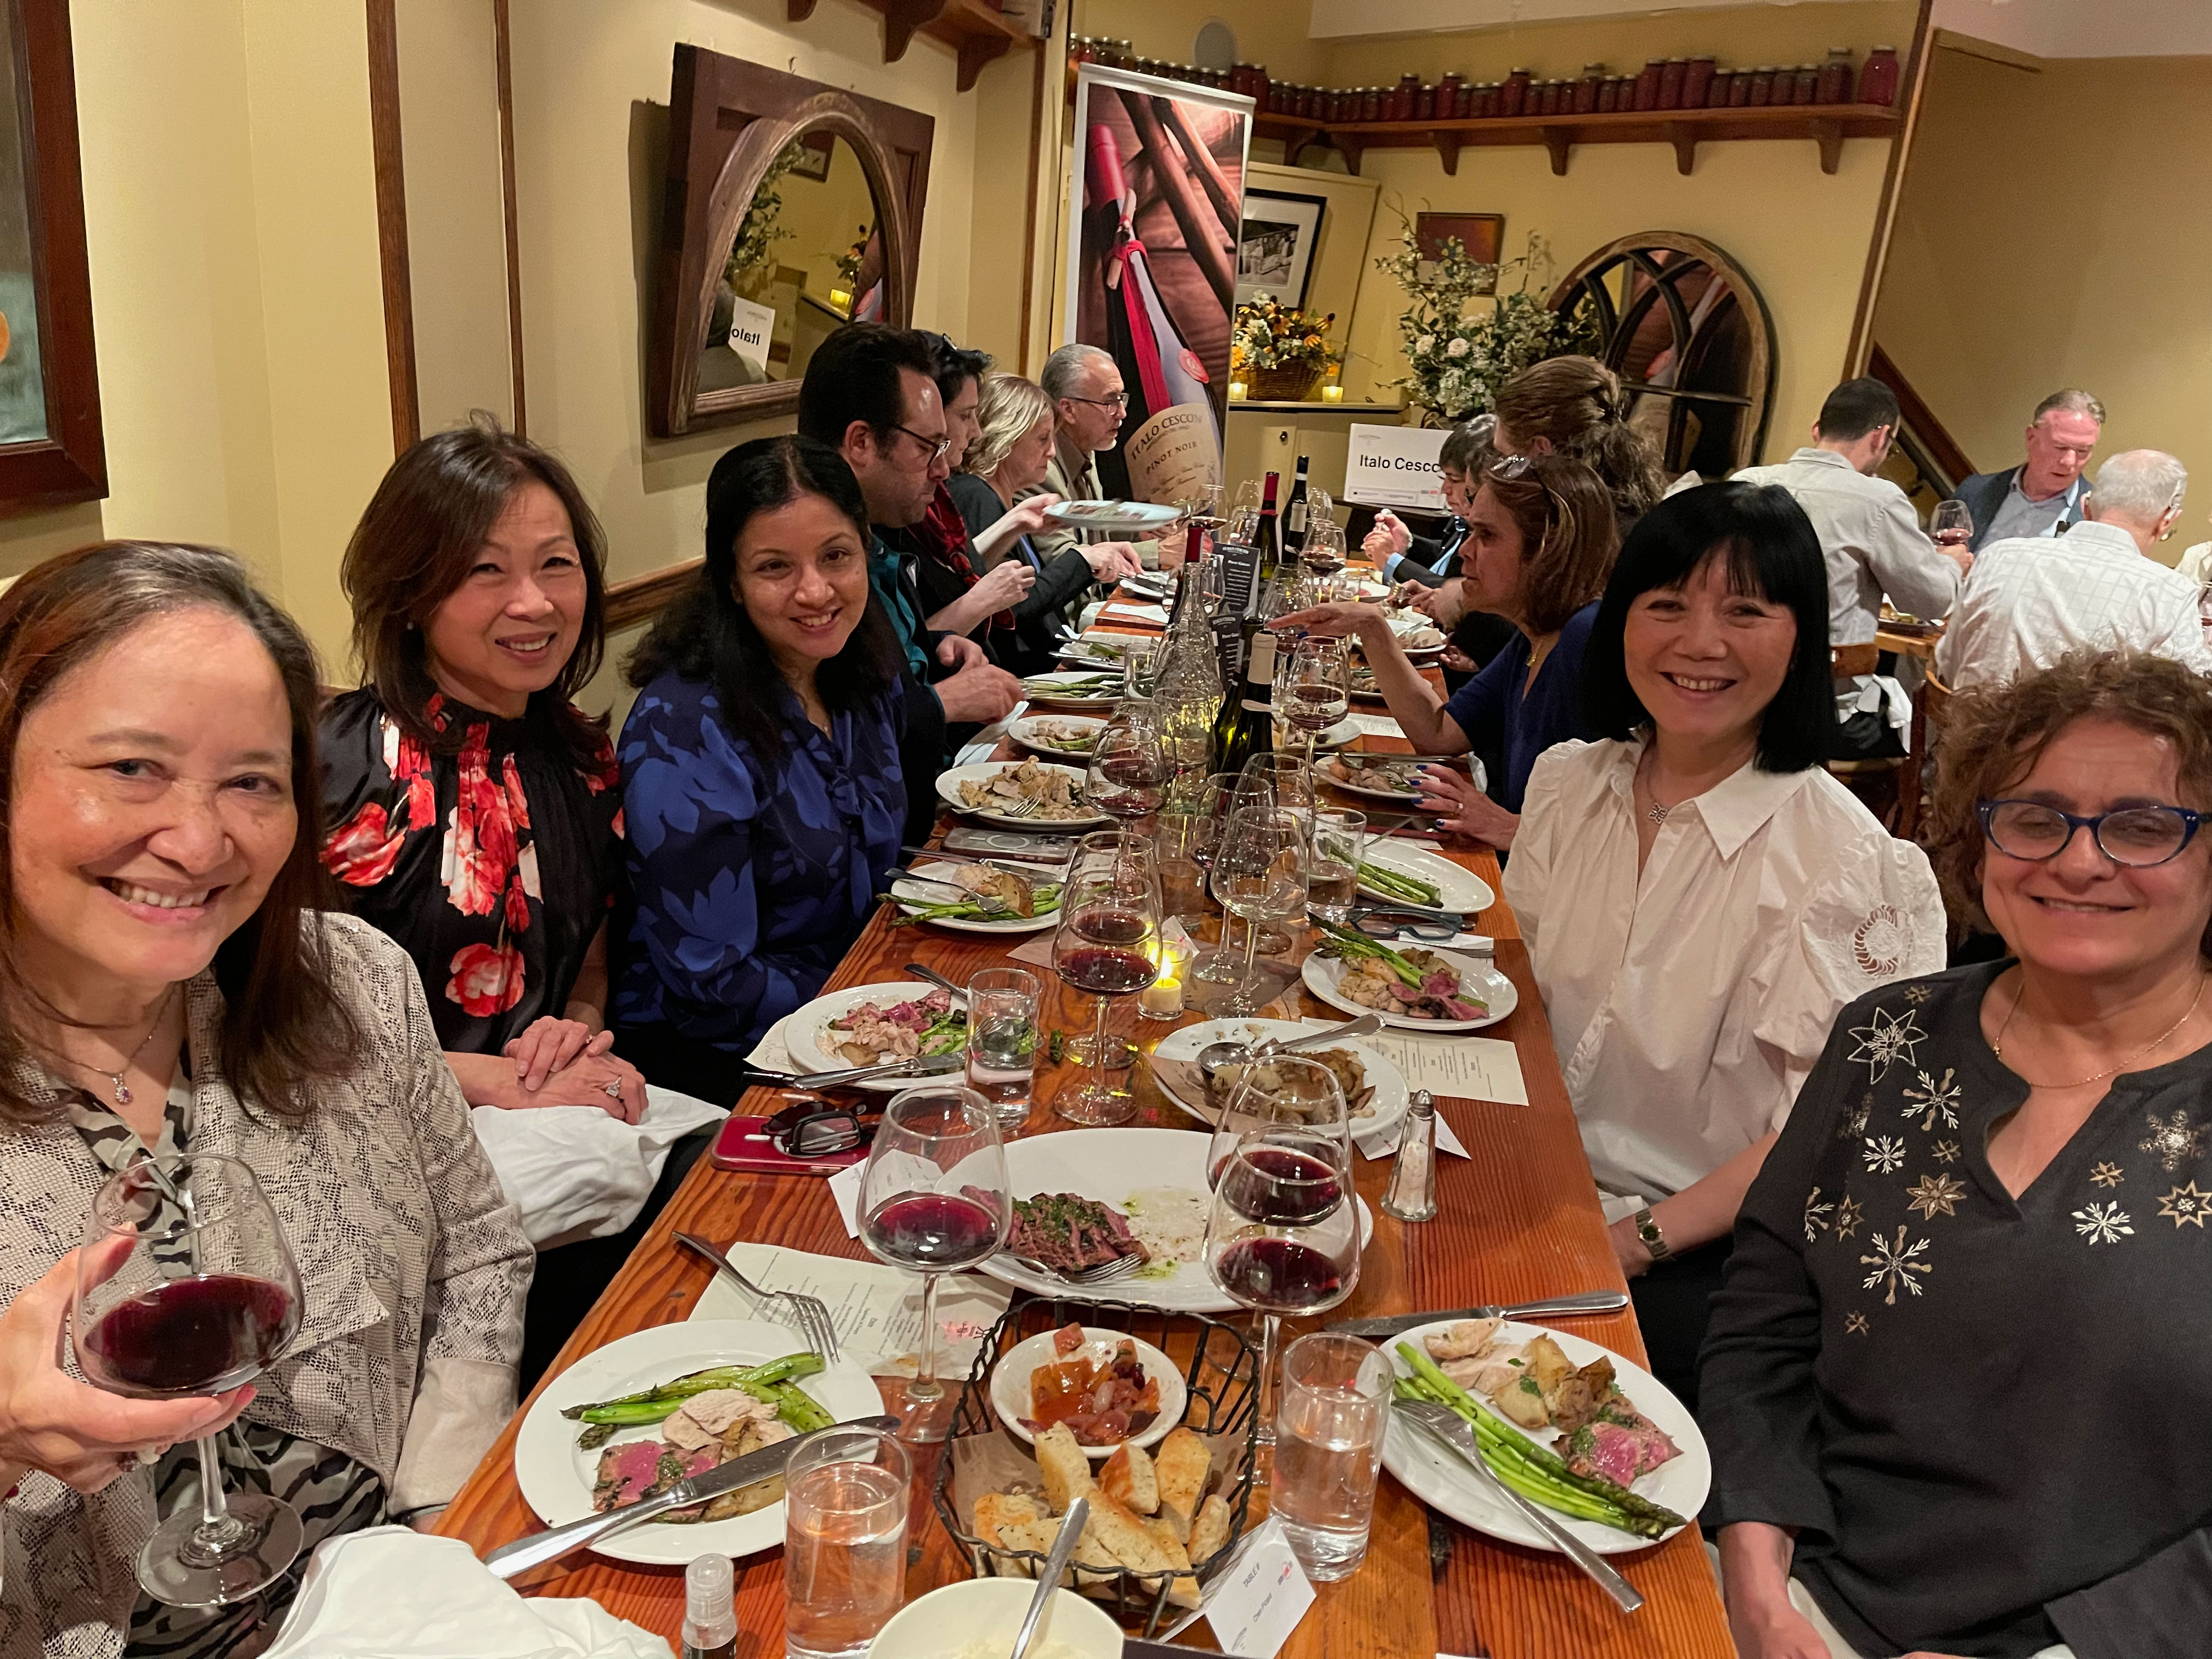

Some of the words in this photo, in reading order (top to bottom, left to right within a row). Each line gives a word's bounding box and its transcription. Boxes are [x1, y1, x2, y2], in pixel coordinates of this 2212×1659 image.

[1131, 425, 1159, 460] ITALO
[1161, 414, 1203, 428] CESCON
[1146, 449, 1172, 475] PINOT
[1175, 441, 1197, 454] NOIR
[1360, 454, 1391, 469] Italo
[1395, 457, 1441, 473] Cesco
